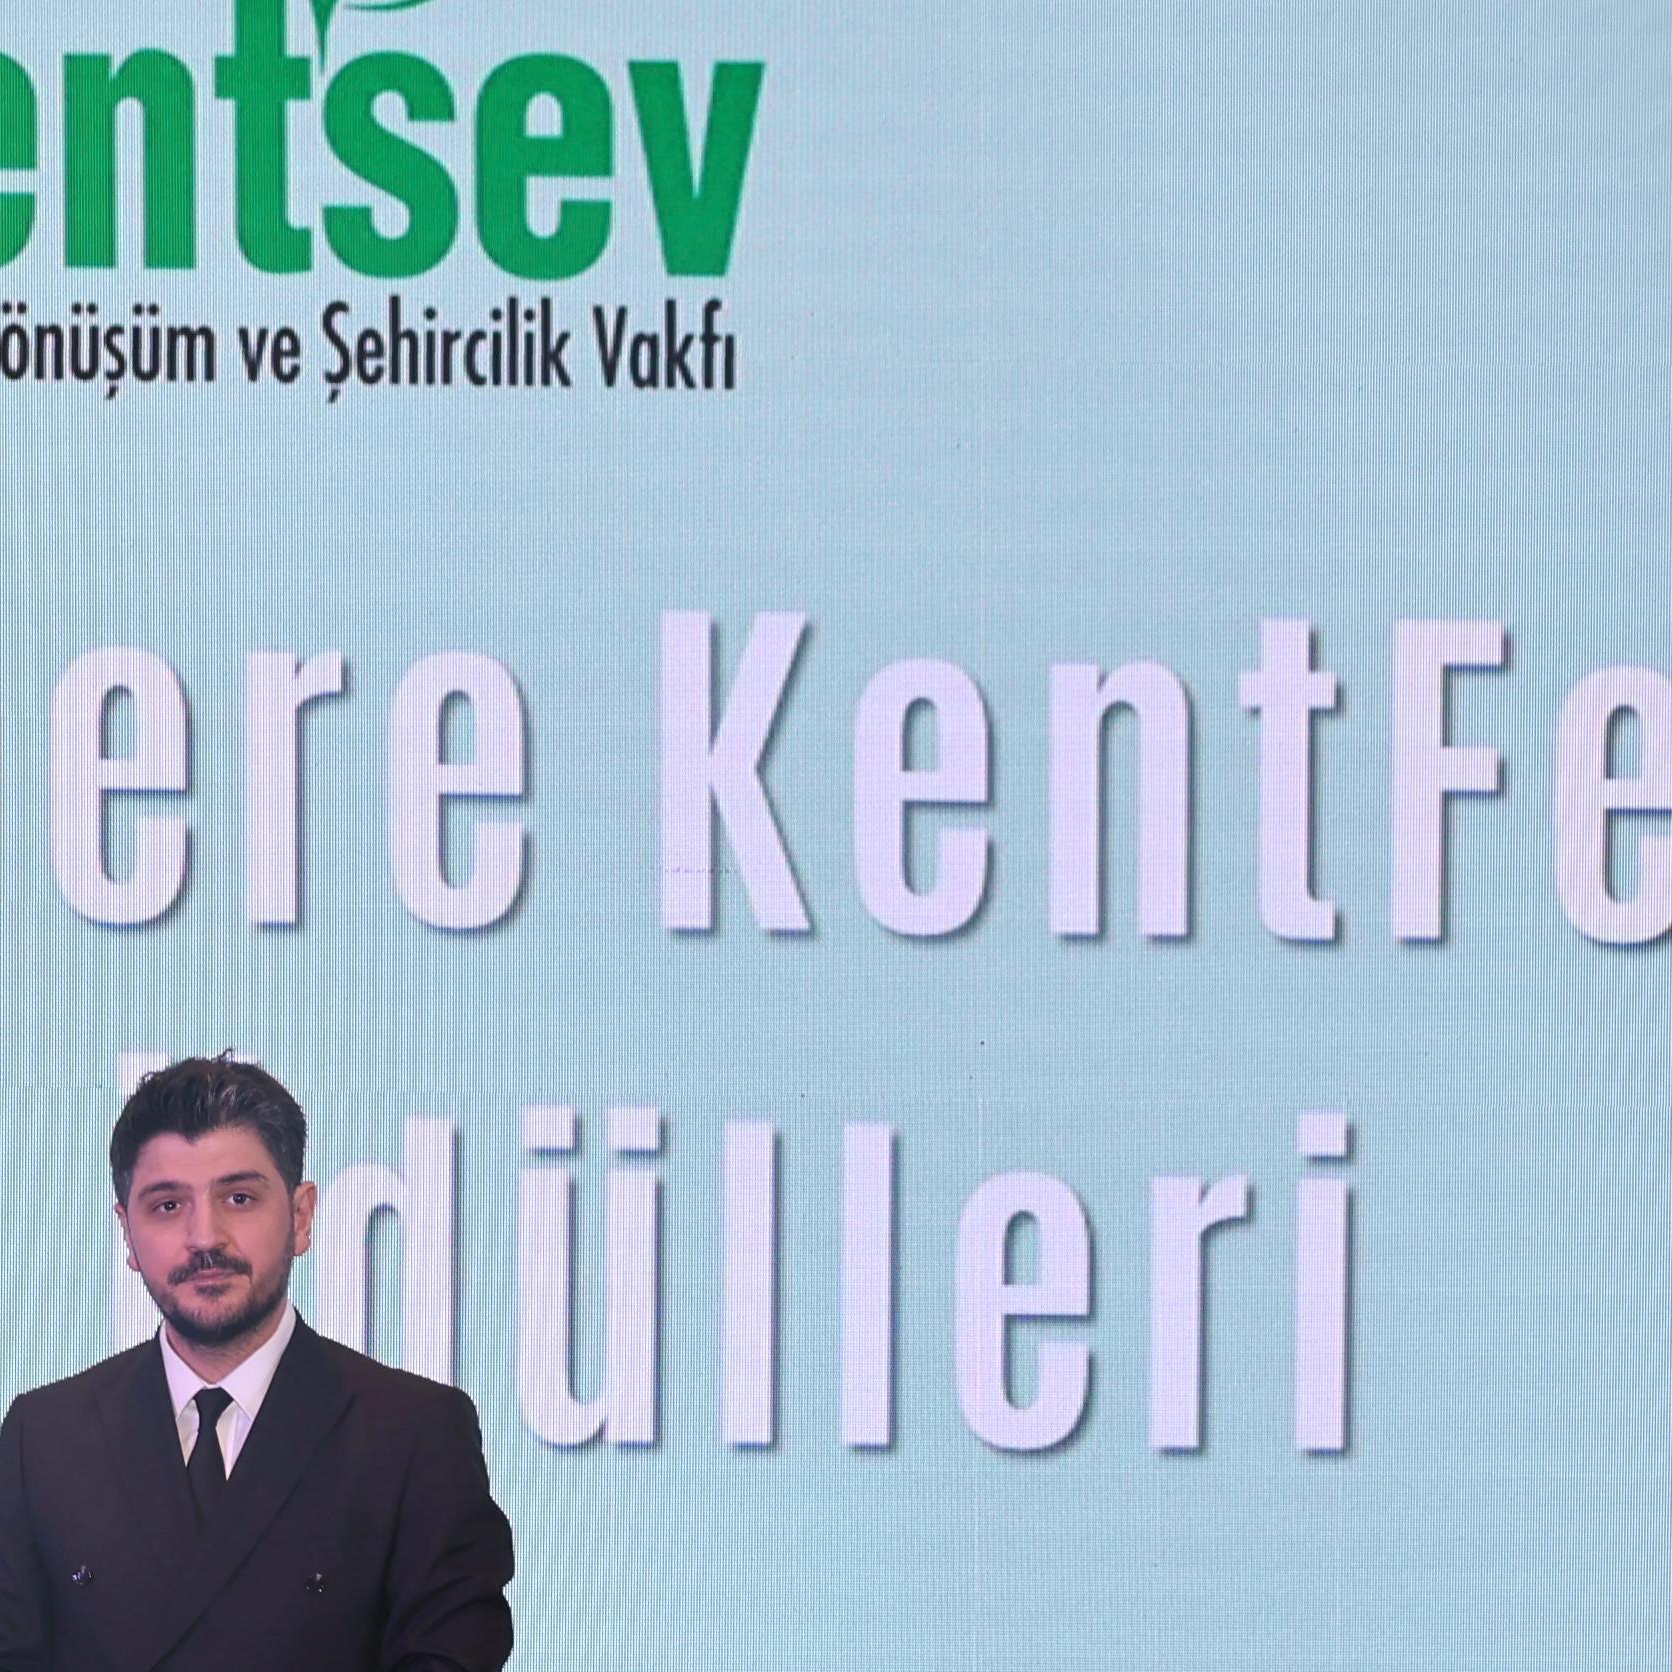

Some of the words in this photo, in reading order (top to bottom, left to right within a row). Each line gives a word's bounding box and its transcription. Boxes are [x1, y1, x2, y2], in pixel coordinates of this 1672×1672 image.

[238, 327, 301, 384] ve
[322, 295, 572, 403] Şehircilik
[593, 299, 735, 390] Vakfı
[661, 609, 1672, 945] KentFe
[112, 1051, 1351, 1454] dülleri
